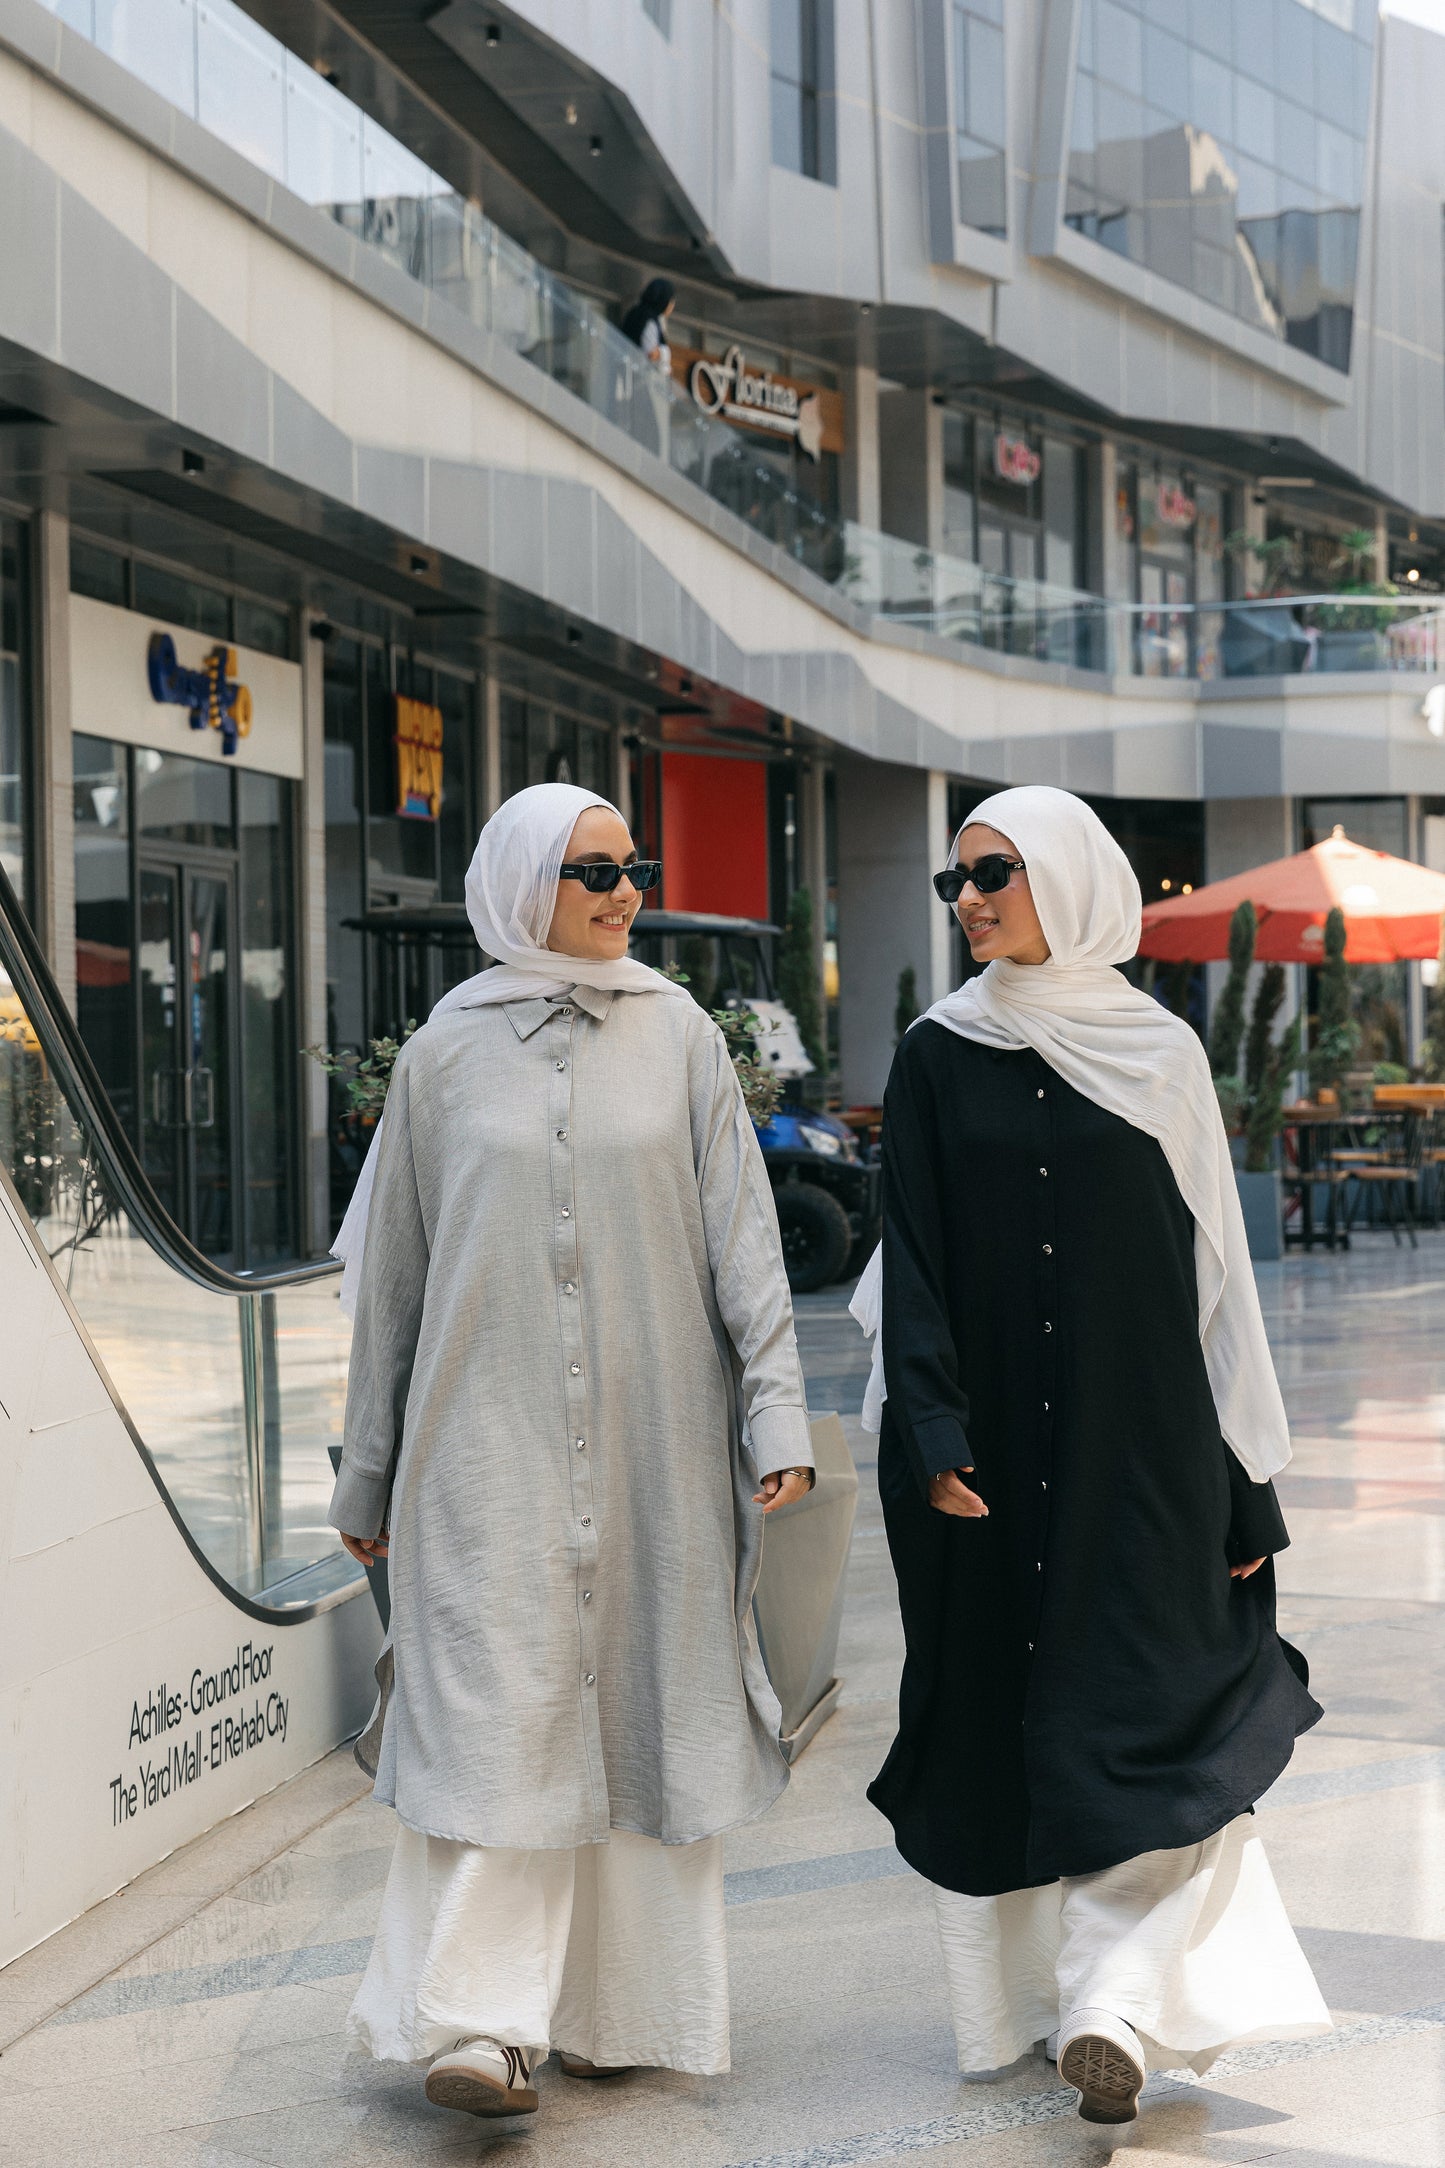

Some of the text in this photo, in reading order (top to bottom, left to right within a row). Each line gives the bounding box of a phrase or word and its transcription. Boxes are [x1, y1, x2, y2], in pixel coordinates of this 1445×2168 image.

[128, 1683, 182, 1750] Achilles
[190, 1646, 240, 1716] Ground
[242, 1640, 274, 1689] Floor
[109, 1773, 137, 1827] The
[139, 1747, 171, 1809] Yard
[173, 1730, 202, 1792] Mall
[210, 1719, 222, 1770] El
[225, 1699, 265, 1762] Rehab
[266, 1691, 289, 1743] City
